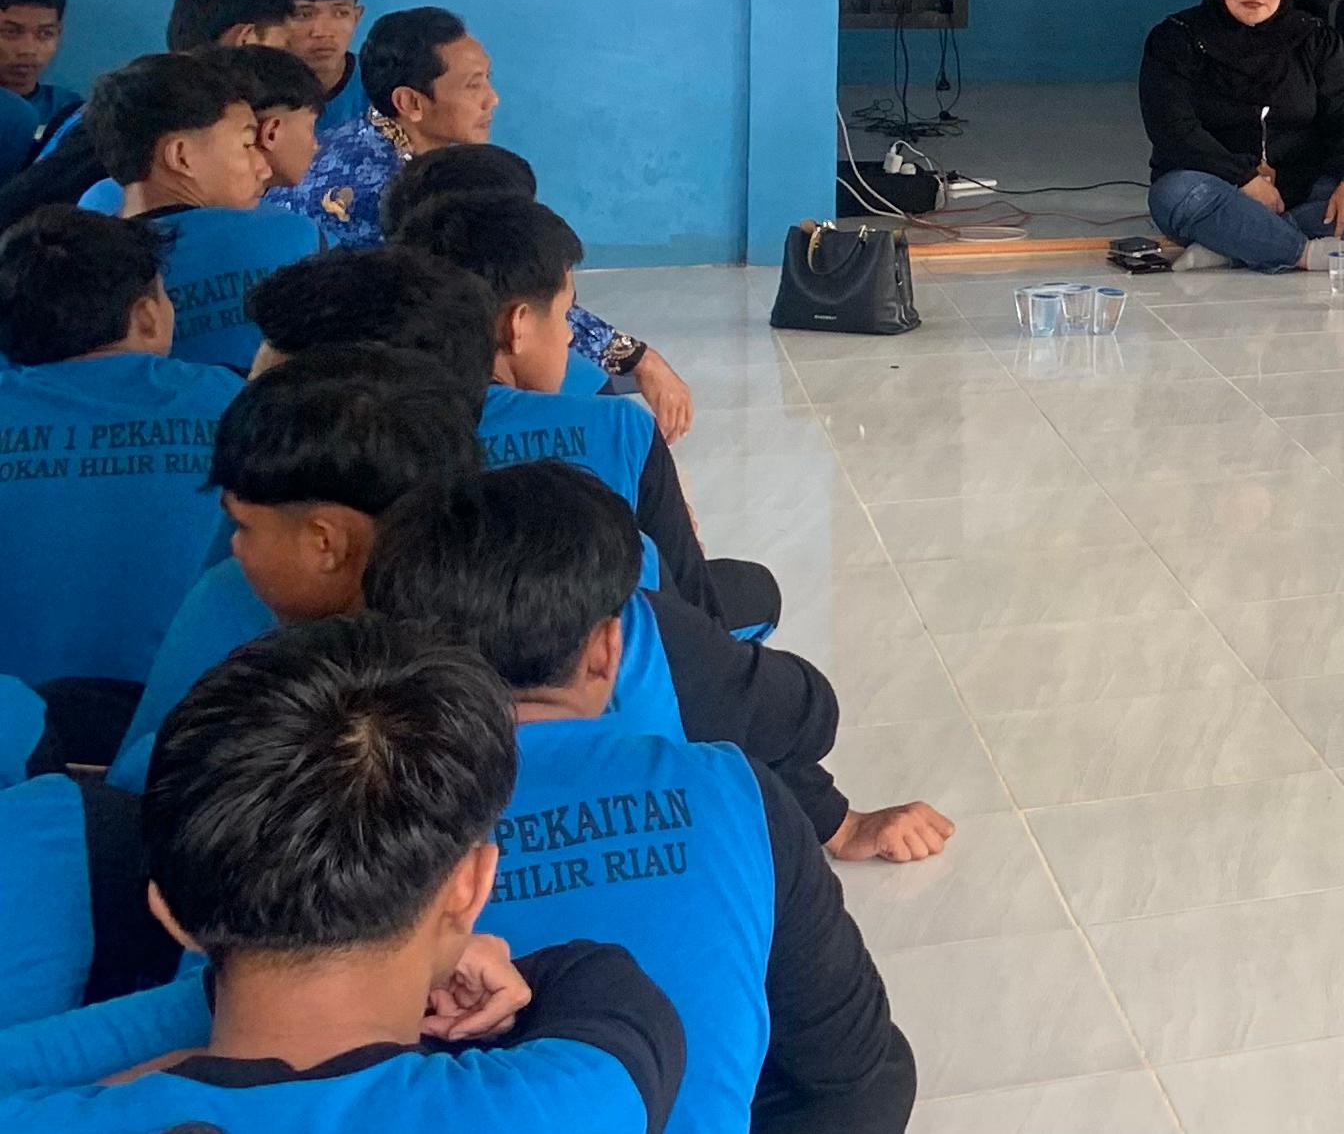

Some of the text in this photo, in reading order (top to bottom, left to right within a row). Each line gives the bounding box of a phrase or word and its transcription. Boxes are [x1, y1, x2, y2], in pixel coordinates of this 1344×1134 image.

[64, 424, 76, 450] 1
[78, 453, 155, 478] HILIR
[495, 788, 692, 856] PEKAITAN
[490, 841, 688, 904] HILIR RIAU
